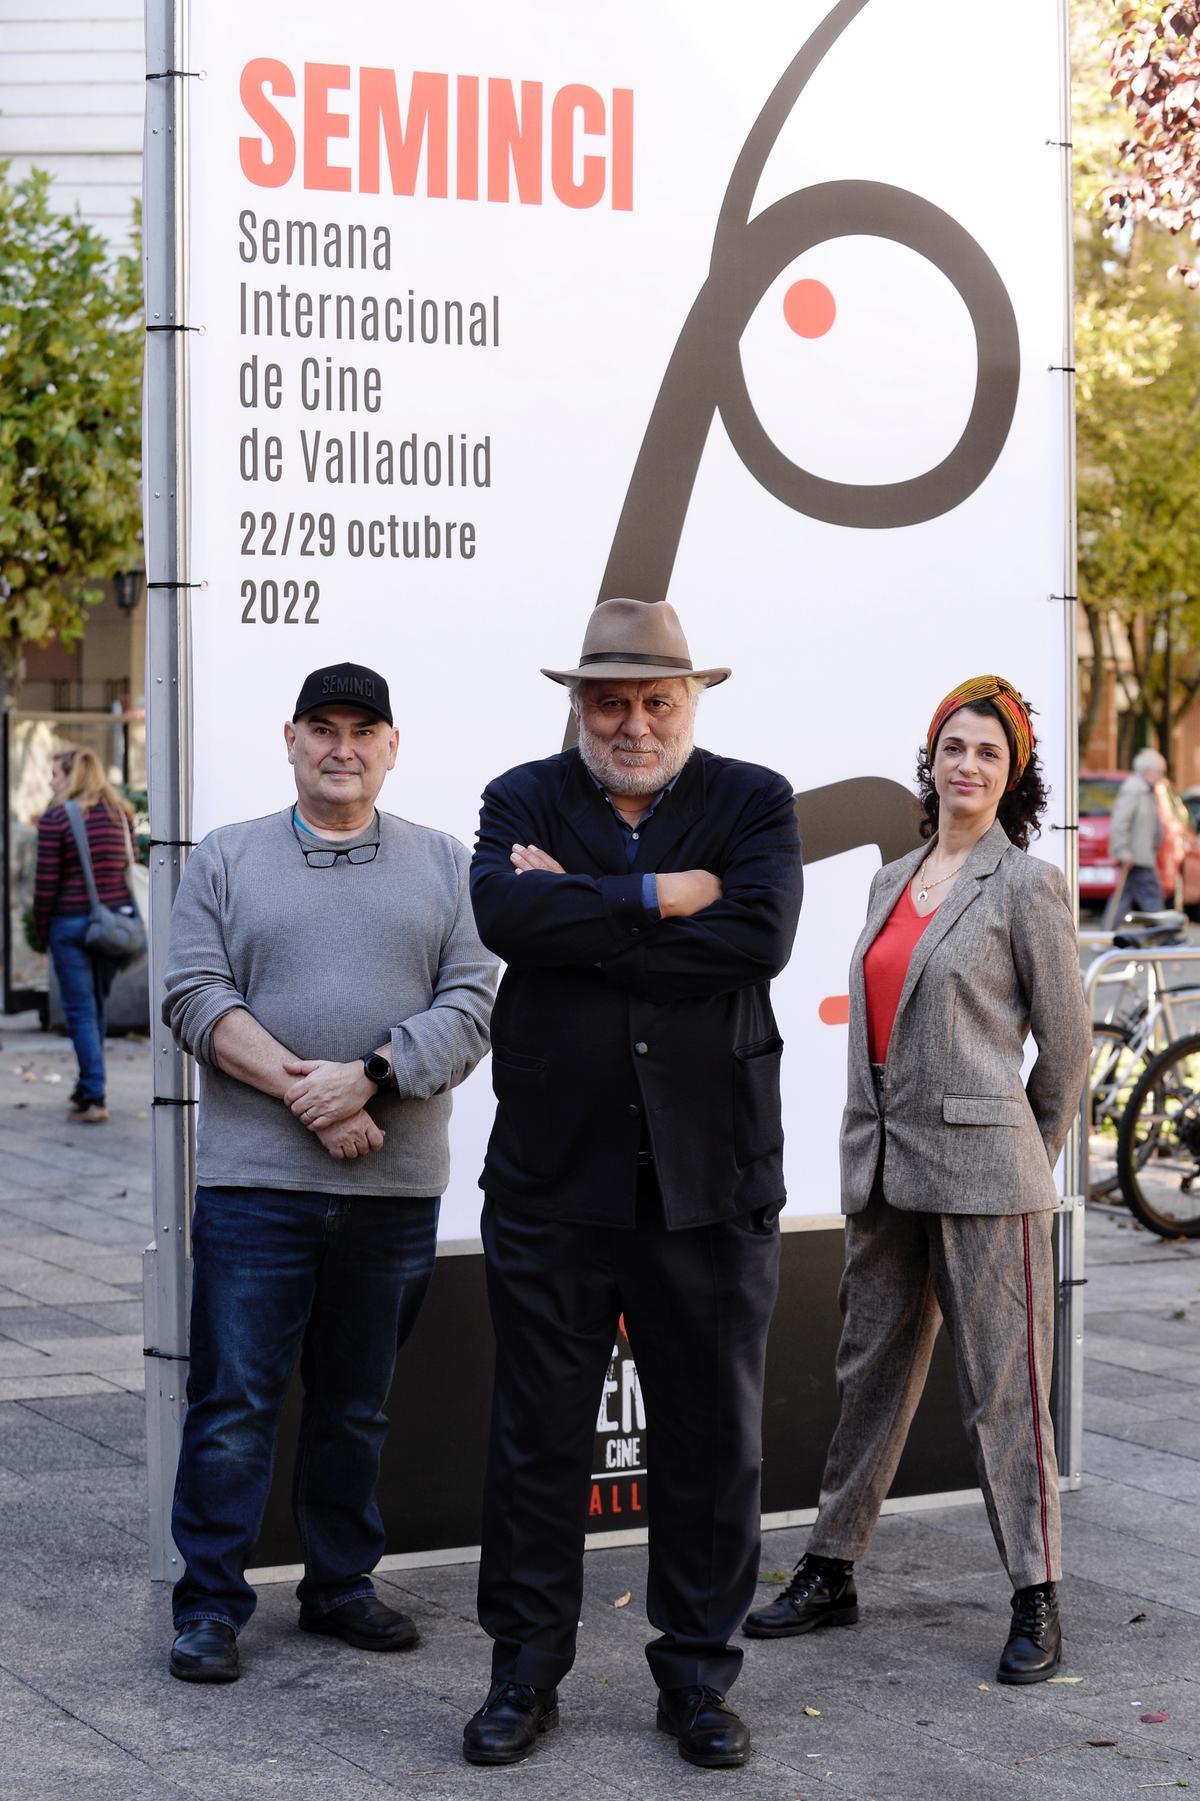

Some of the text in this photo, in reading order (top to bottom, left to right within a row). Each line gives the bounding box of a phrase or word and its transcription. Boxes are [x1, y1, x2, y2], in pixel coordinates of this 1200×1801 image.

[239, 57, 633, 210] SEMINCI
[239, 209, 392, 271] Semana
[240, 282, 499, 347] Internacional
[239, 354, 382, 413] de Cine
[239, 427, 492, 488] de Valladolid
[240, 511, 476, 560] 22/29 octubre
[240, 579, 321, 625] 2022
[322, 675, 376, 699] SEMINCI
[605, 1437, 641, 1469] CINE
